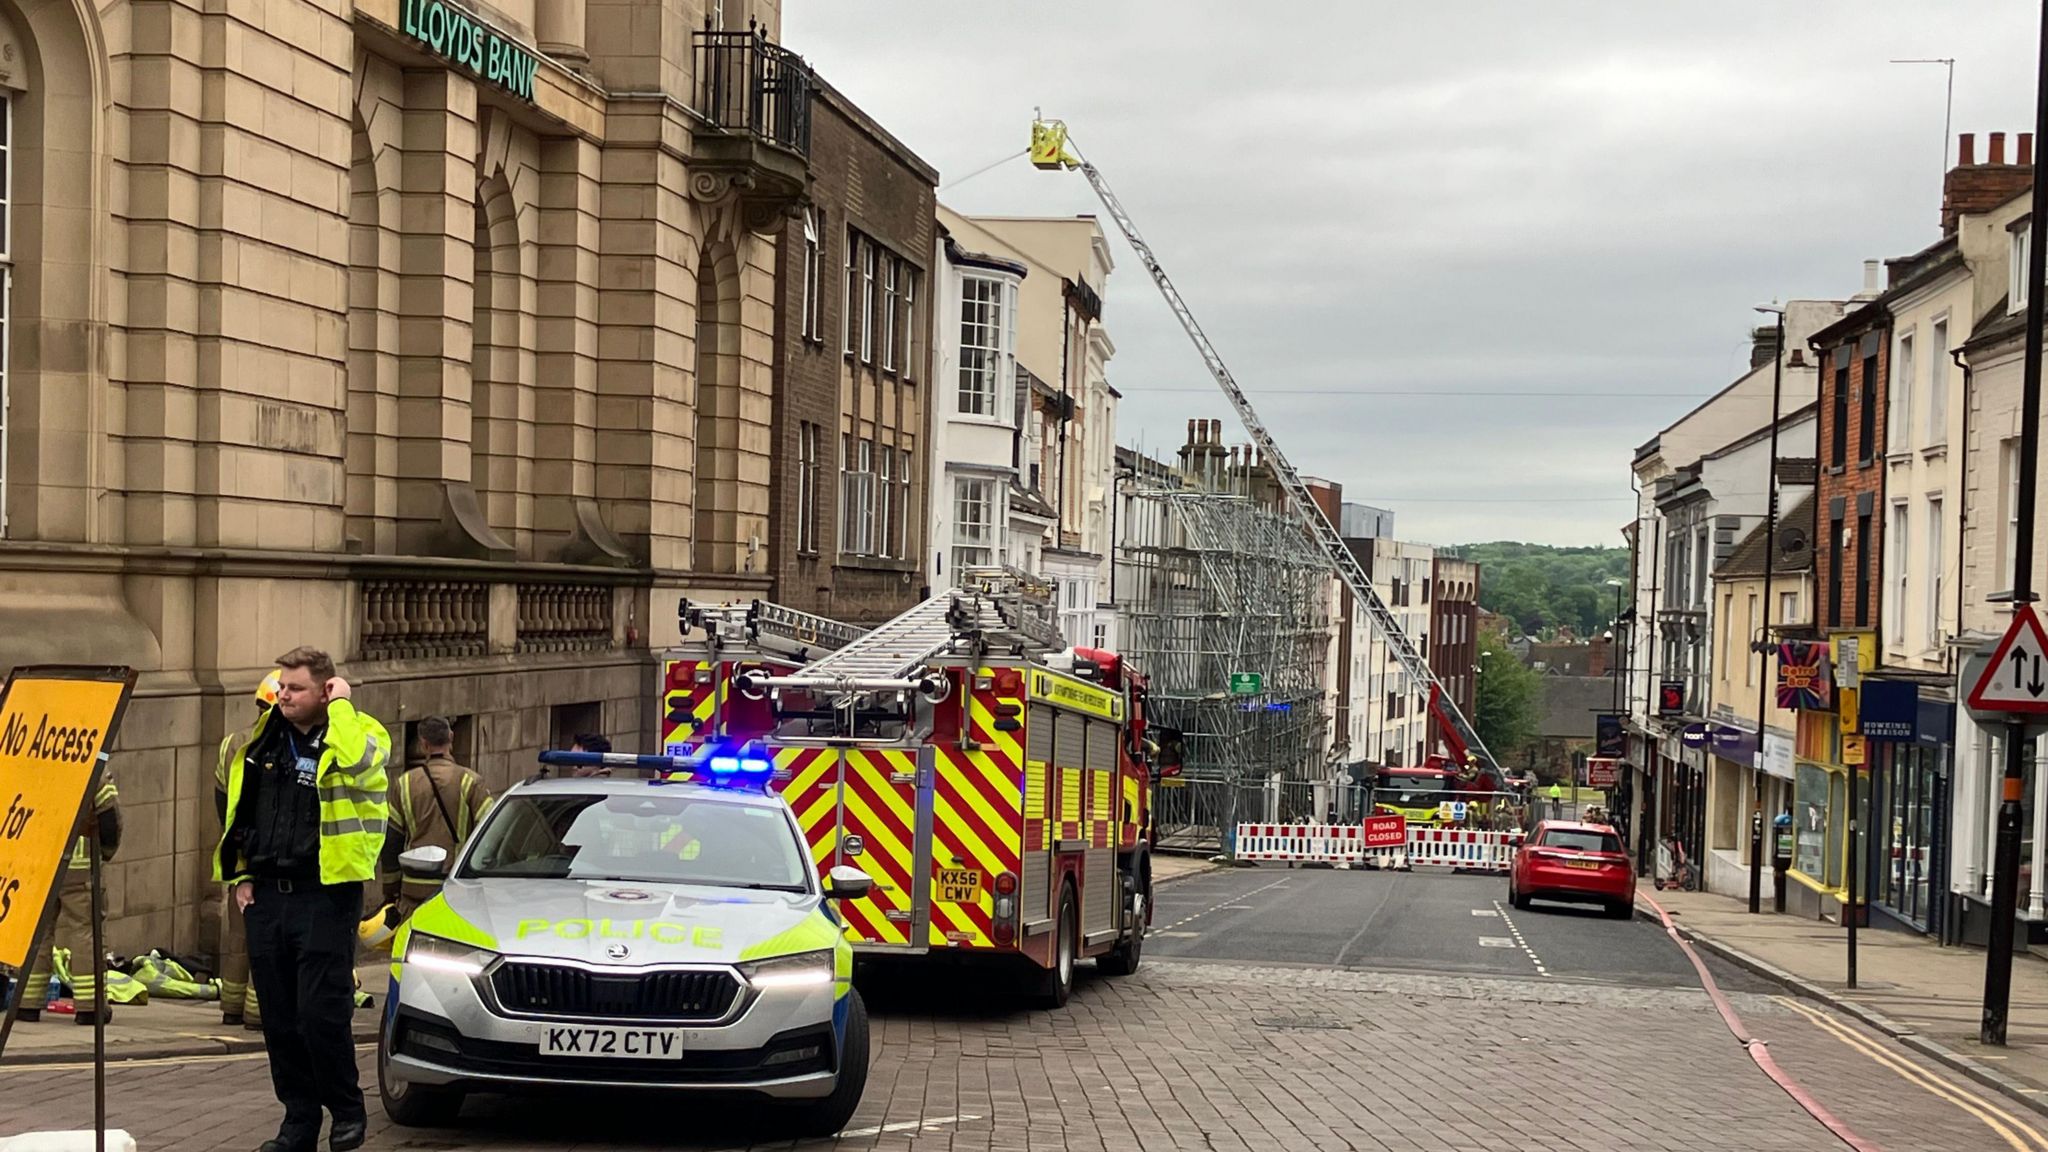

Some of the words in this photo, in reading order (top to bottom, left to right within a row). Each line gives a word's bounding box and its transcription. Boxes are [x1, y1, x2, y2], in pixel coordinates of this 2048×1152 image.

[406, 0, 484, 74] LLOYDS
[488, 35, 539, 104] BANK
[1781, 665, 1817, 677] Retro
[1787, 676, 1811, 688] Bar
[1863, 721, 1906, 729] HOWKINS
[0, 712, 28, 756] No
[27, 713, 98, 763] Access
[1684, 732, 1704, 740] haart
[667, 745, 692, 756] FEM
[0, 793, 34, 840] for
[1372, 822, 1397, 831] ROAD
[1368, 833, 1402, 842] CLOSED
[941, 872, 977, 885] KX56
[945, 887, 972, 900] CWV
[516, 917, 724, 949] POLICE
[549, 1028, 617, 1053] KX72
[624, 1031, 675, 1055] CTV
